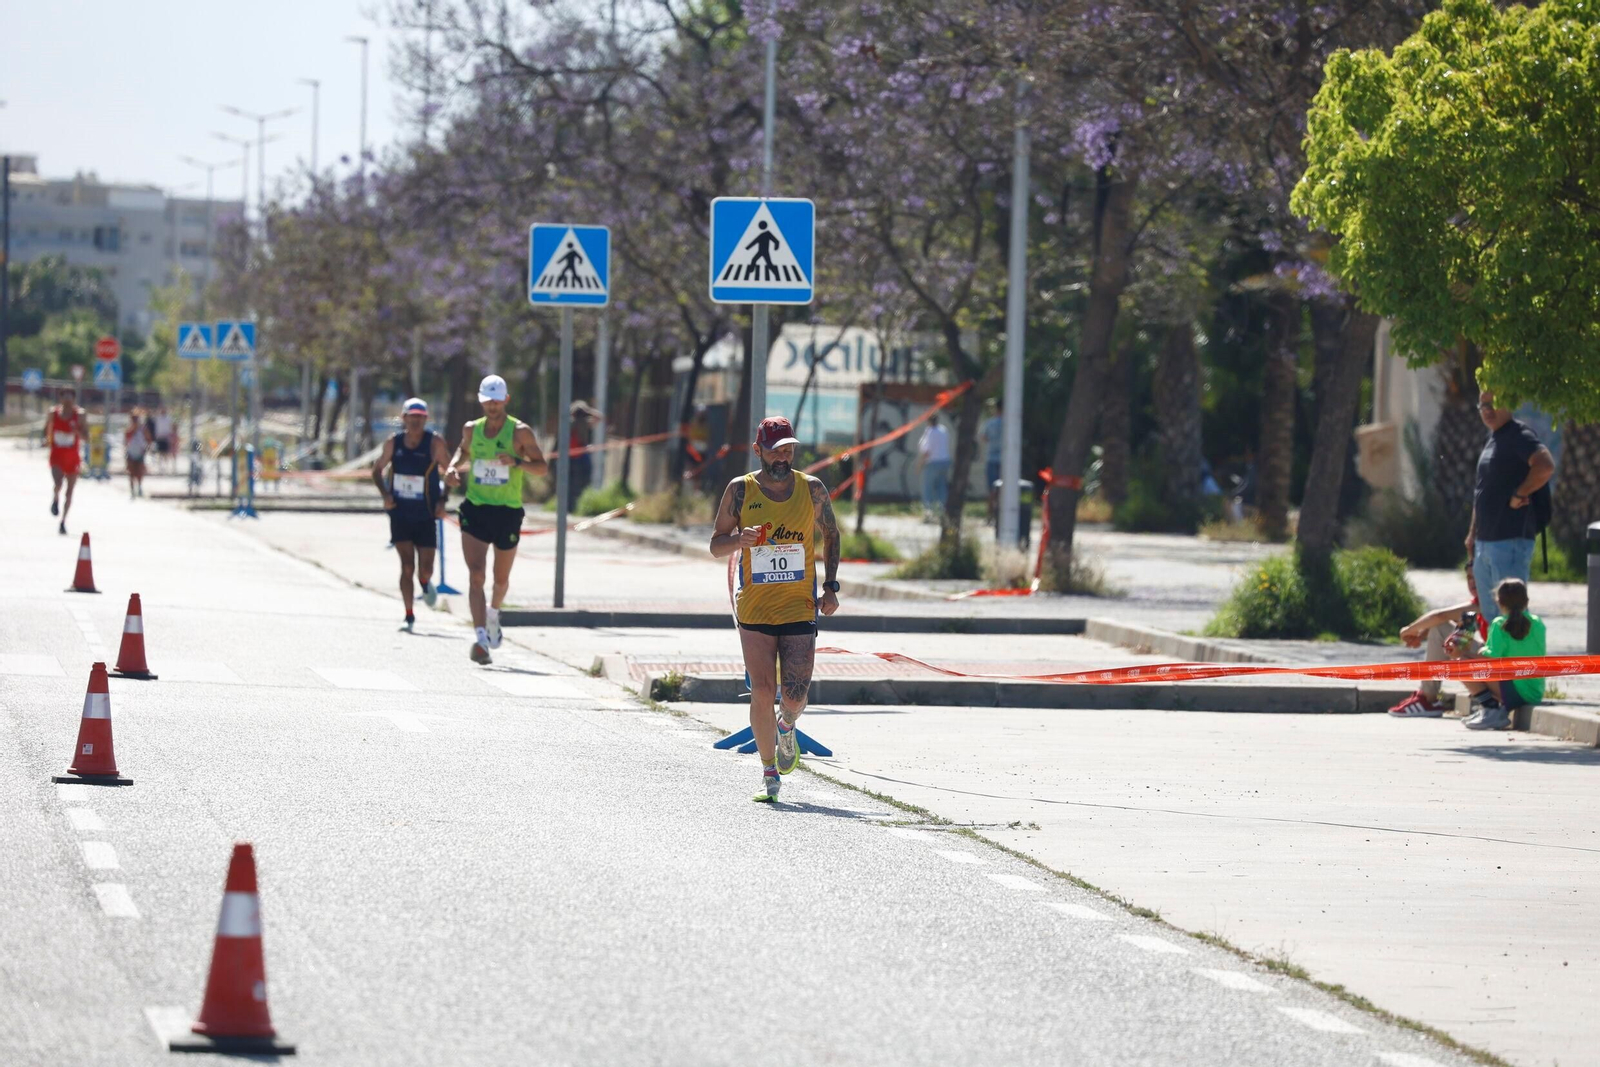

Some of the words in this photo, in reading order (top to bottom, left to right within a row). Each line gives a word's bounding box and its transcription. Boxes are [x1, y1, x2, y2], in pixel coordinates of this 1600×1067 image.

[484, 467, 497, 478] 20
[749, 502, 762, 510] vive
[771, 523, 805, 541] Álora
[770, 557, 787, 571] 10
